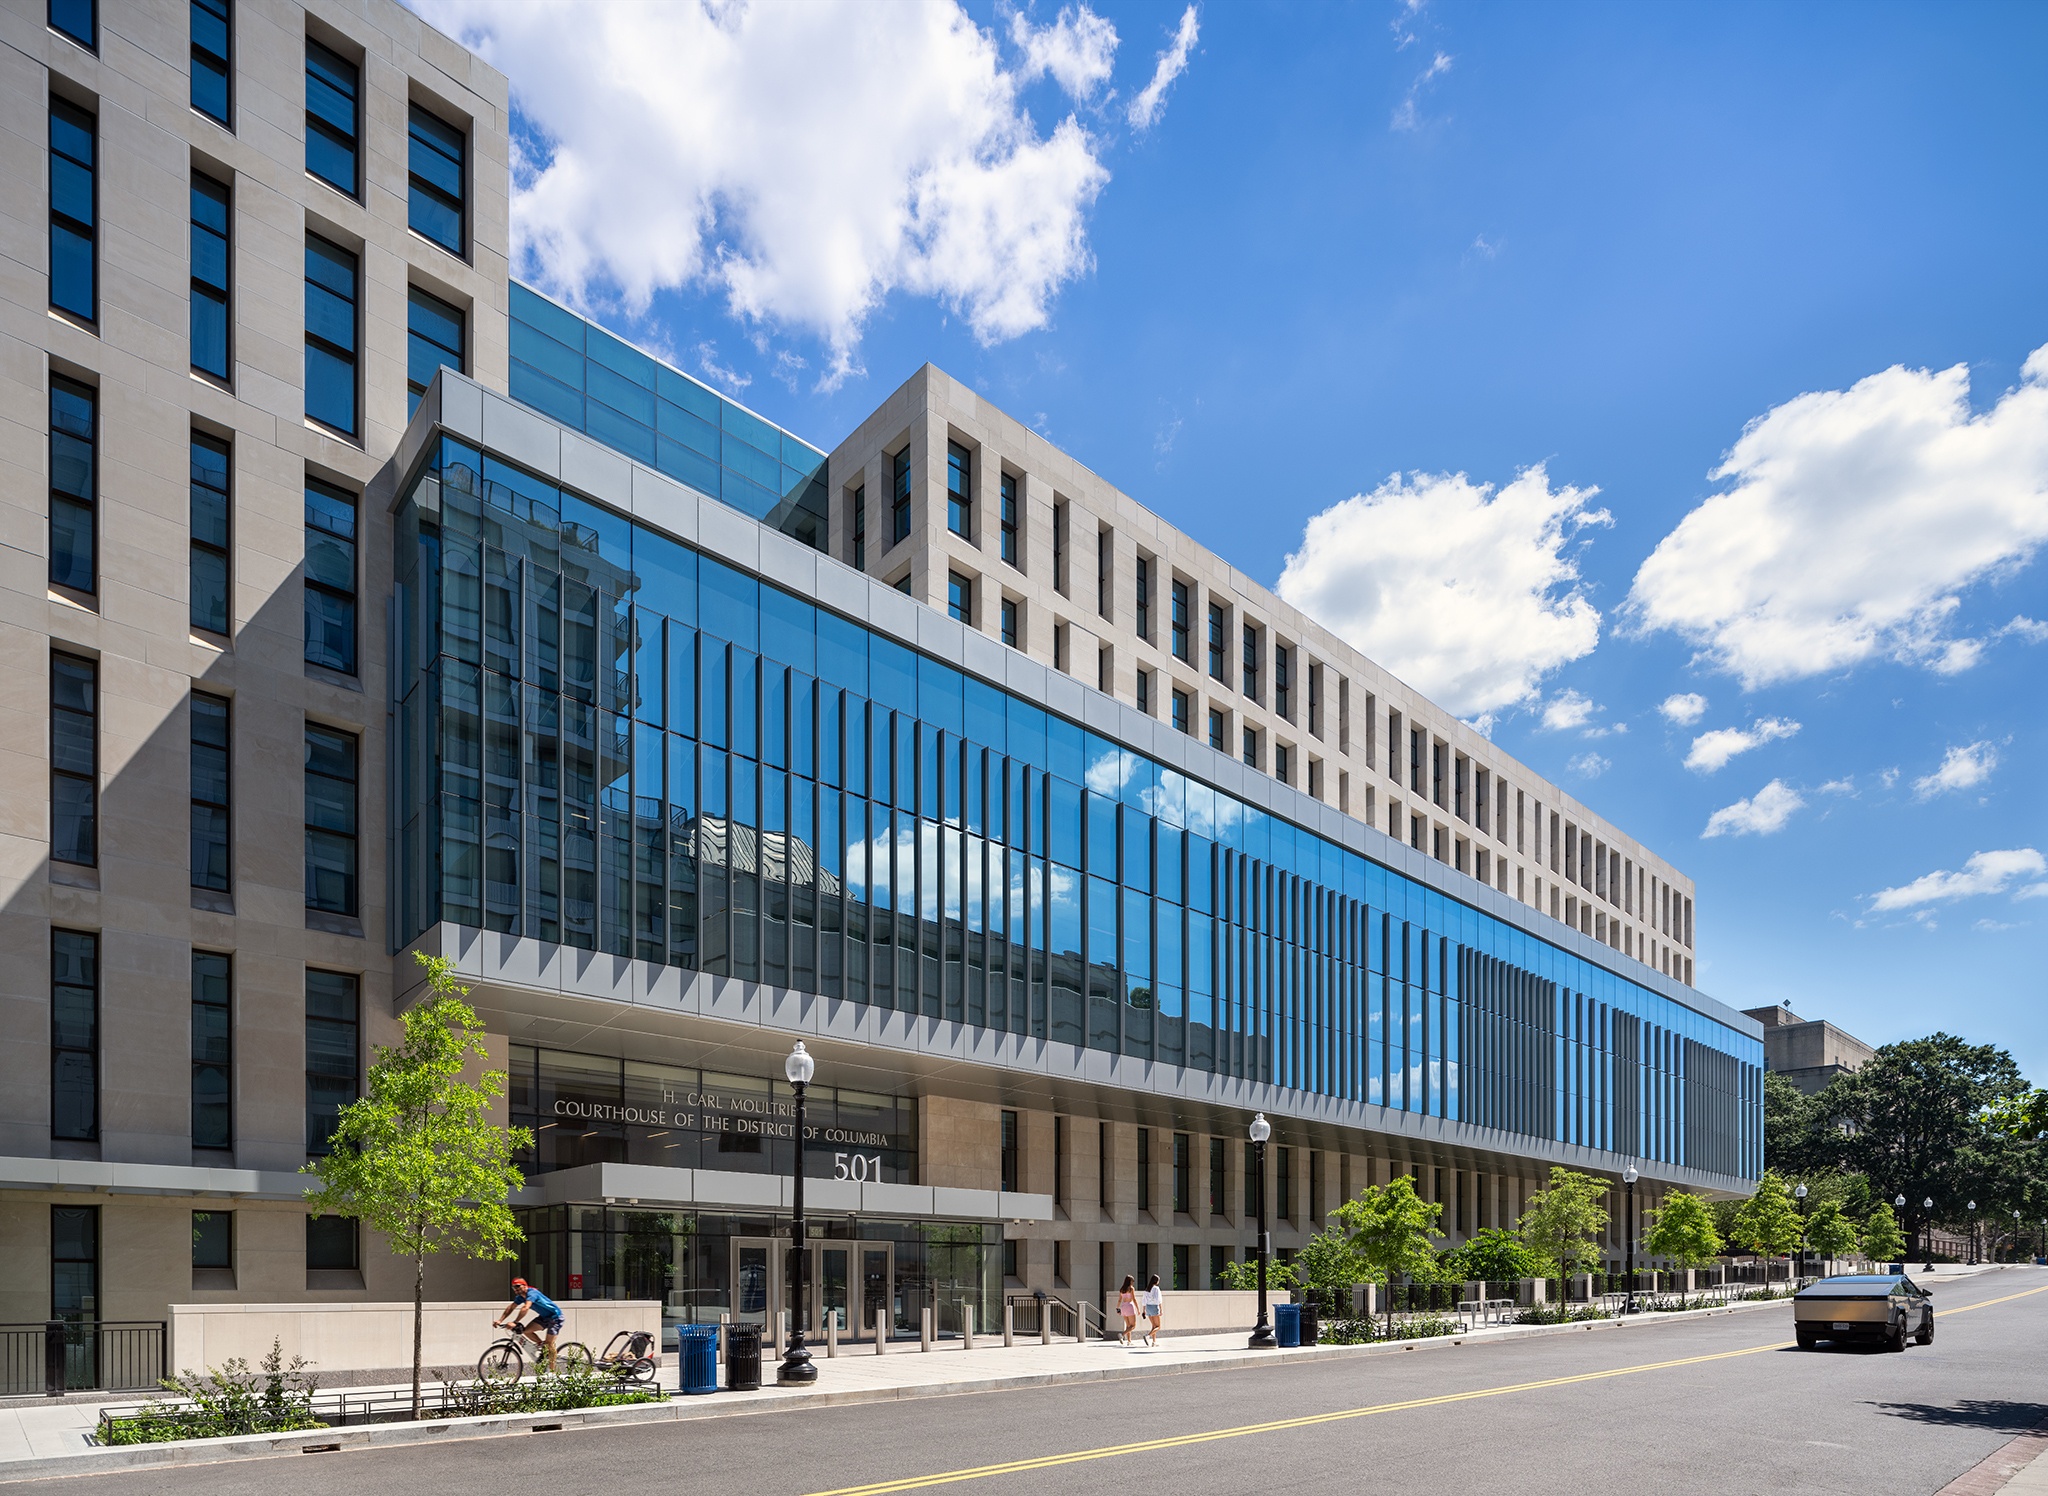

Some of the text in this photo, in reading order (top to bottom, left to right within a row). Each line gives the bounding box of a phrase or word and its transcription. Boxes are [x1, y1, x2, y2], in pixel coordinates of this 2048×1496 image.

[663, 1089, 679, 1104] H.
[687, 1092, 722, 1109] CARL
[730, 1098, 796, 1117] MOULTRIE
[554, 1100, 888, 1146] COURTHOUSE OF THE DISTRICT OF COLUMBIA
[834, 1152, 881, 1184] 501
[810, 1228, 822, 1236] 501
